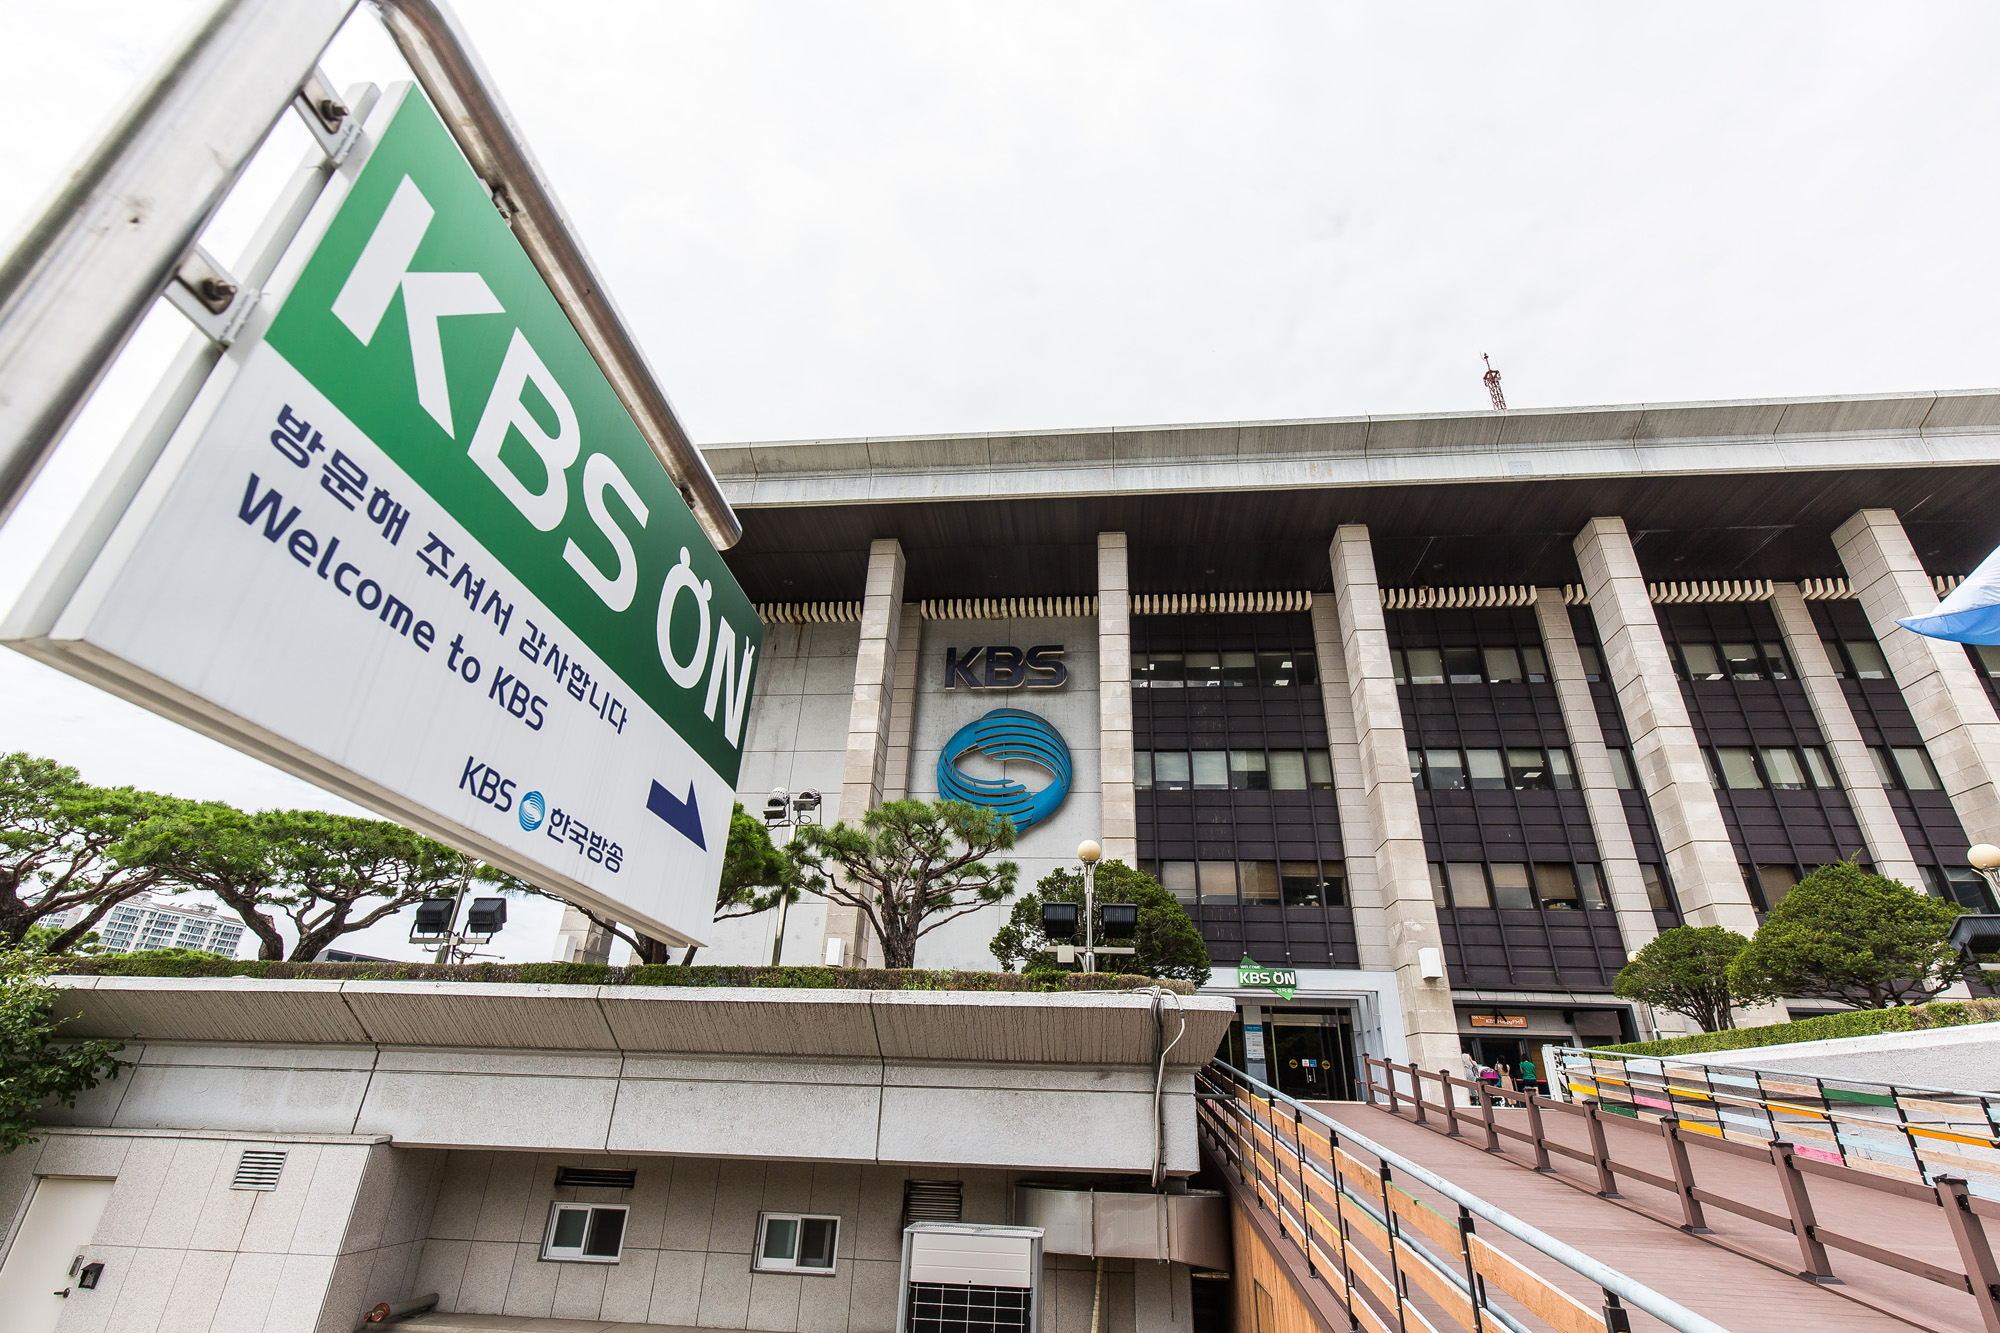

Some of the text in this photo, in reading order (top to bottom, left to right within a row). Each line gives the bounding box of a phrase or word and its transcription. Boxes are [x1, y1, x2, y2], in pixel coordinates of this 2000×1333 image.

[331, 173, 649, 612] KBS
[238, 472, 549, 731] Welcome to KBS
[270, 403, 628, 735] 방문해 주셔서 감사합니다
[945, 644, 1068, 690] KBS
[458, 756, 517, 813] KBS
[547, 807, 624, 874] 한국방송
[1240, 972, 1271, 985] KBS
